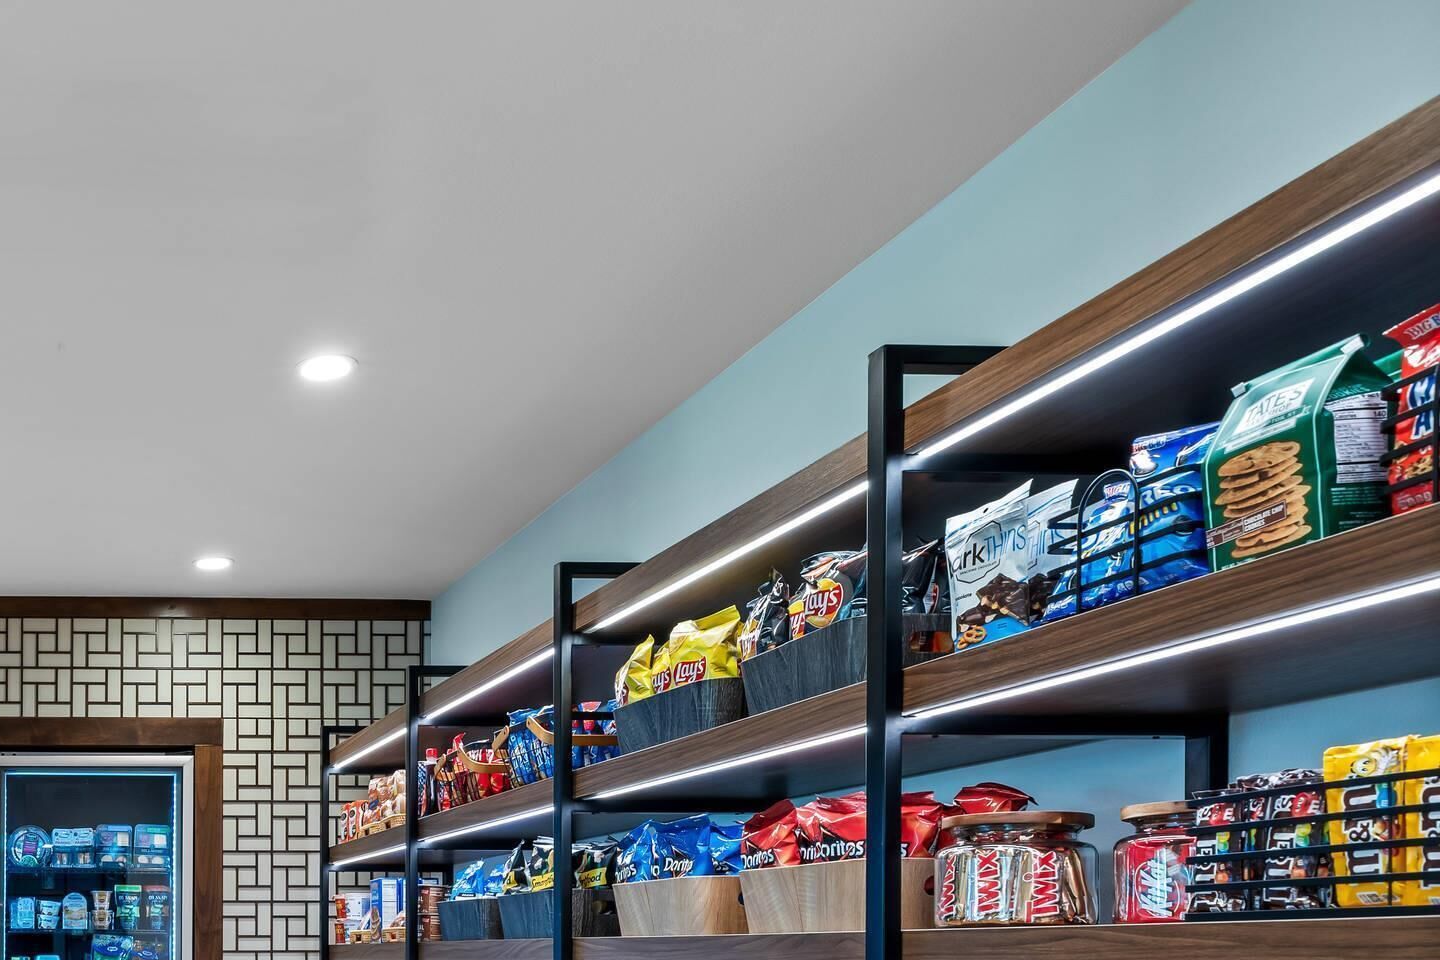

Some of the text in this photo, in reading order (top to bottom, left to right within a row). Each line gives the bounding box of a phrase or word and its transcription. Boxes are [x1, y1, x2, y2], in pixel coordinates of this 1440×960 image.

[652, 669, 670, 692] ay's
[675, 659, 705, 683] Lay's
[663, 857, 695, 872] Dorito
